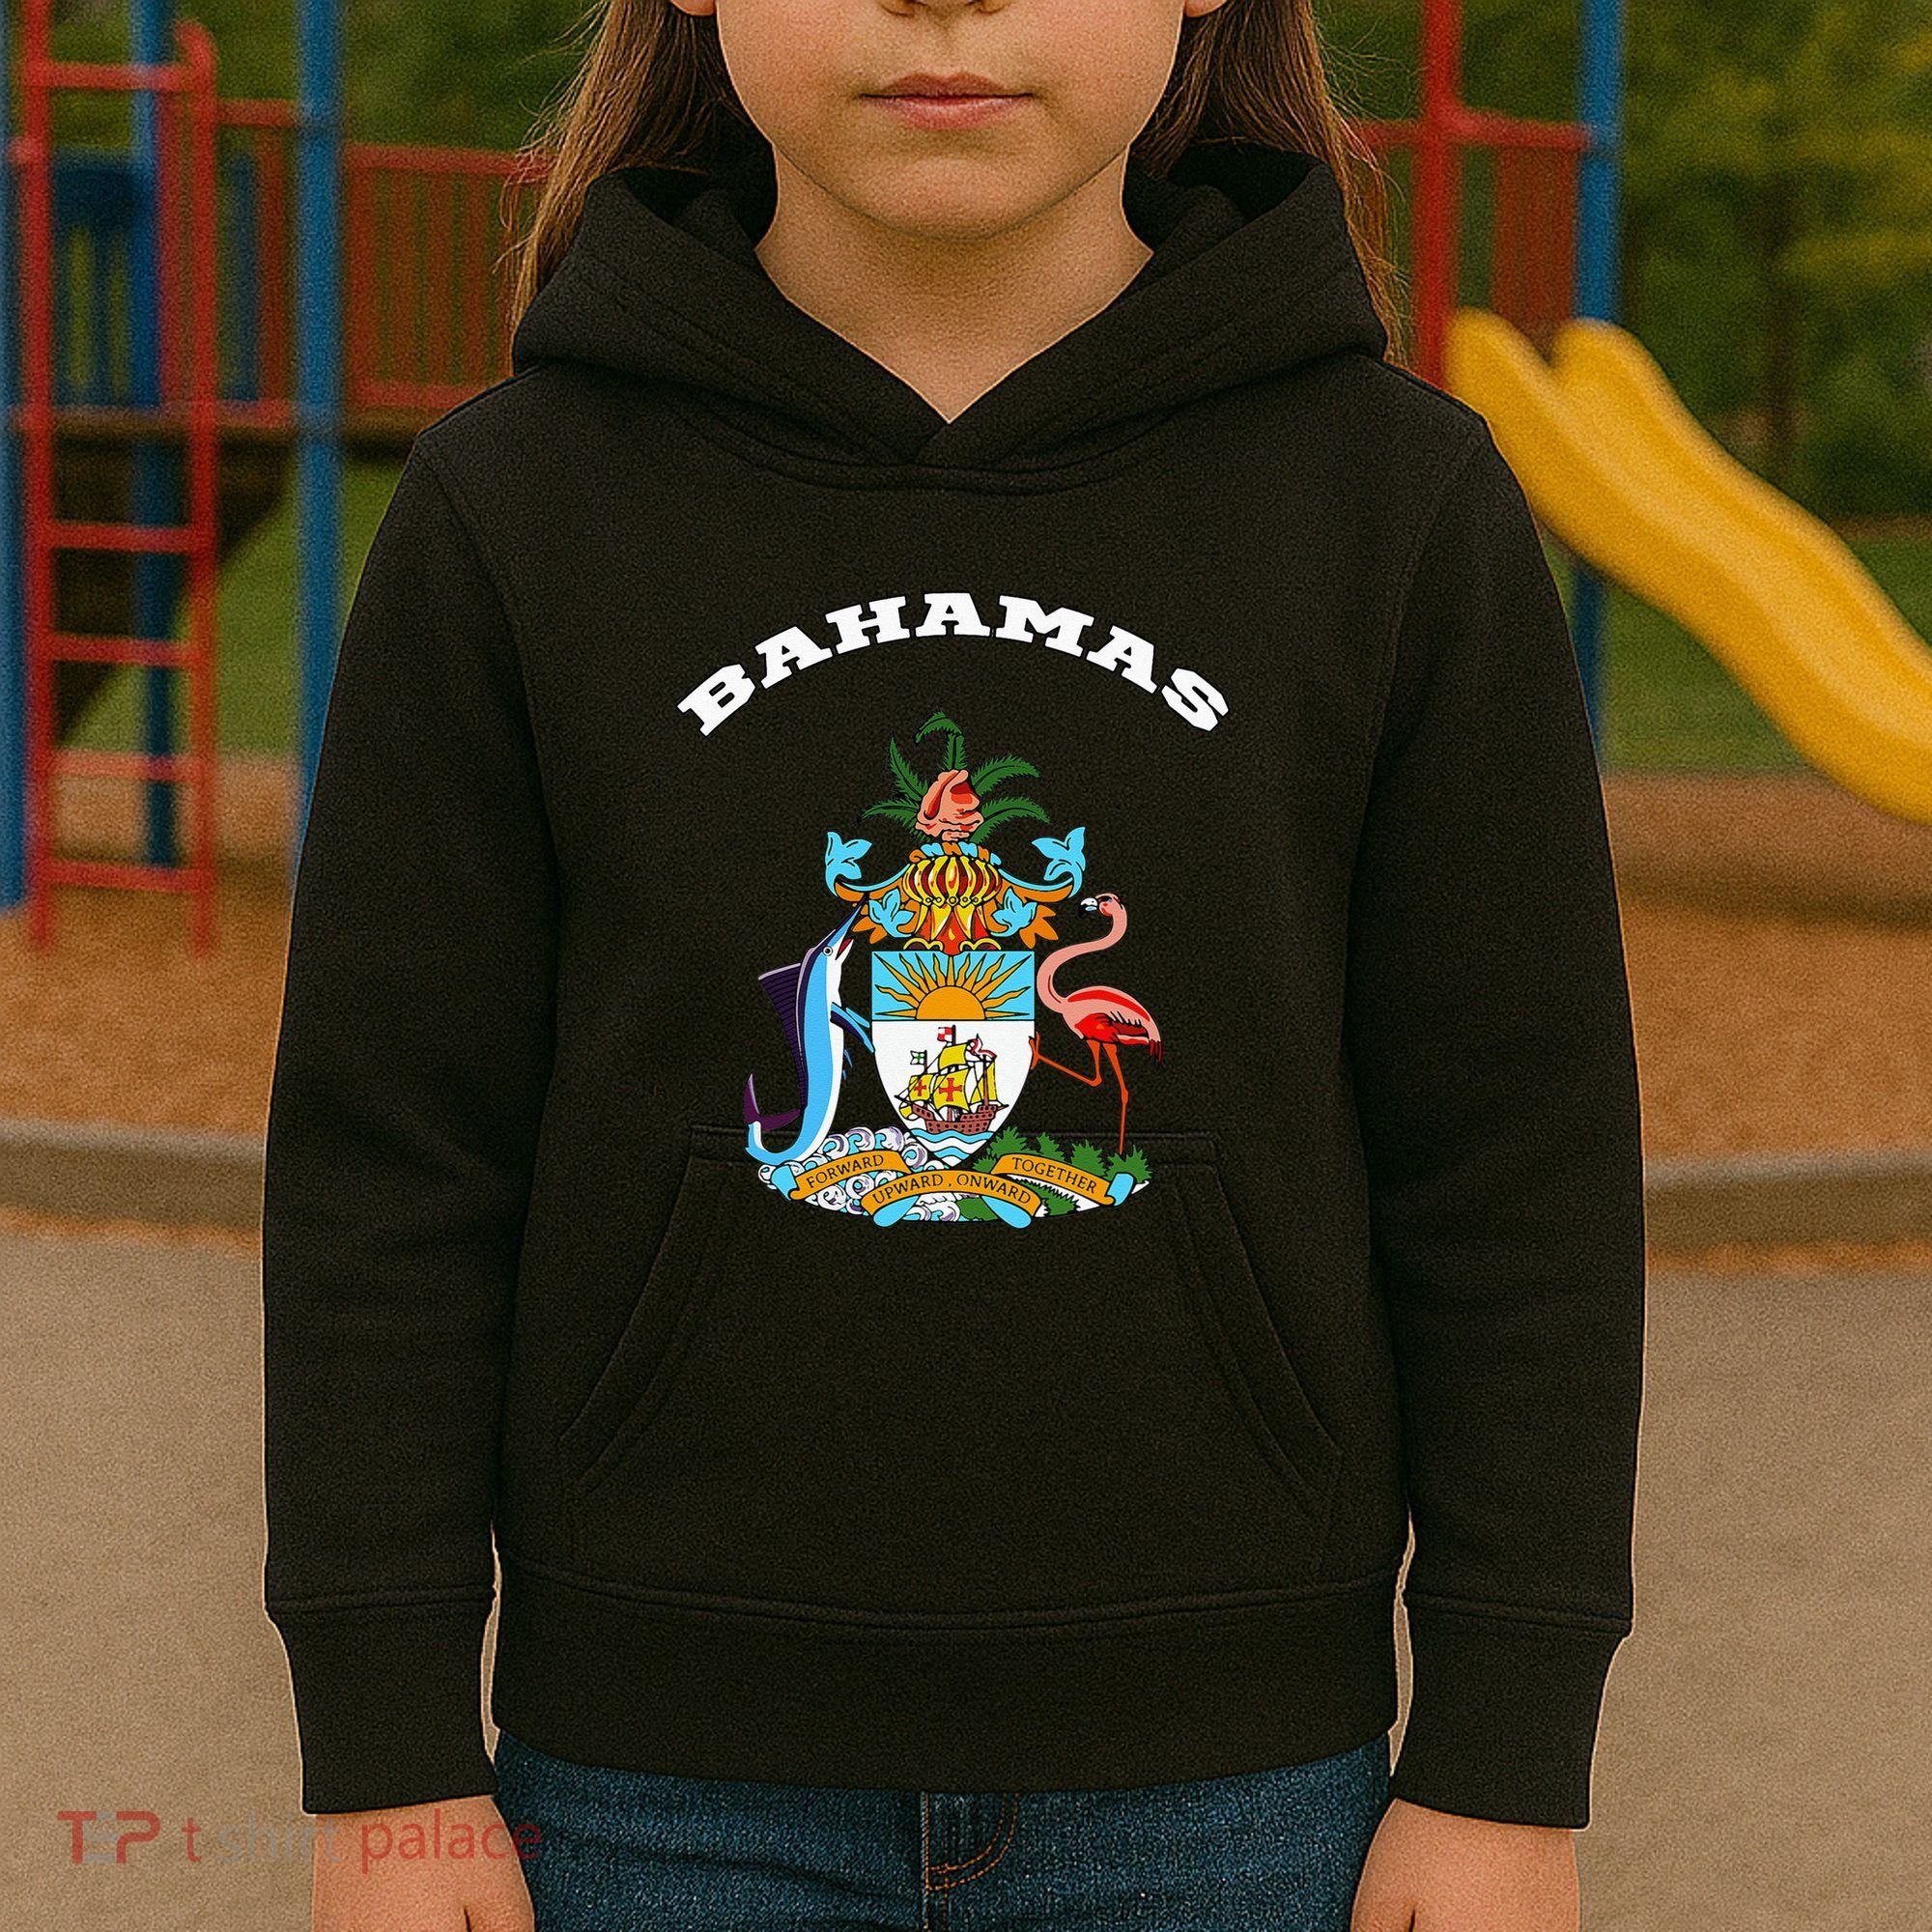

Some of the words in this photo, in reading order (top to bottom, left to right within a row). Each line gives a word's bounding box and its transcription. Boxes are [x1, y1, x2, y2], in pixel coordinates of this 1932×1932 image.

[677, 592, 1229, 736] BAHAMAS
[806, 1154, 884, 1188] FORWARD
[1011, 1157, 1097, 1194] TOGETHER
[956, 1173, 1031, 1205] ONWARD
